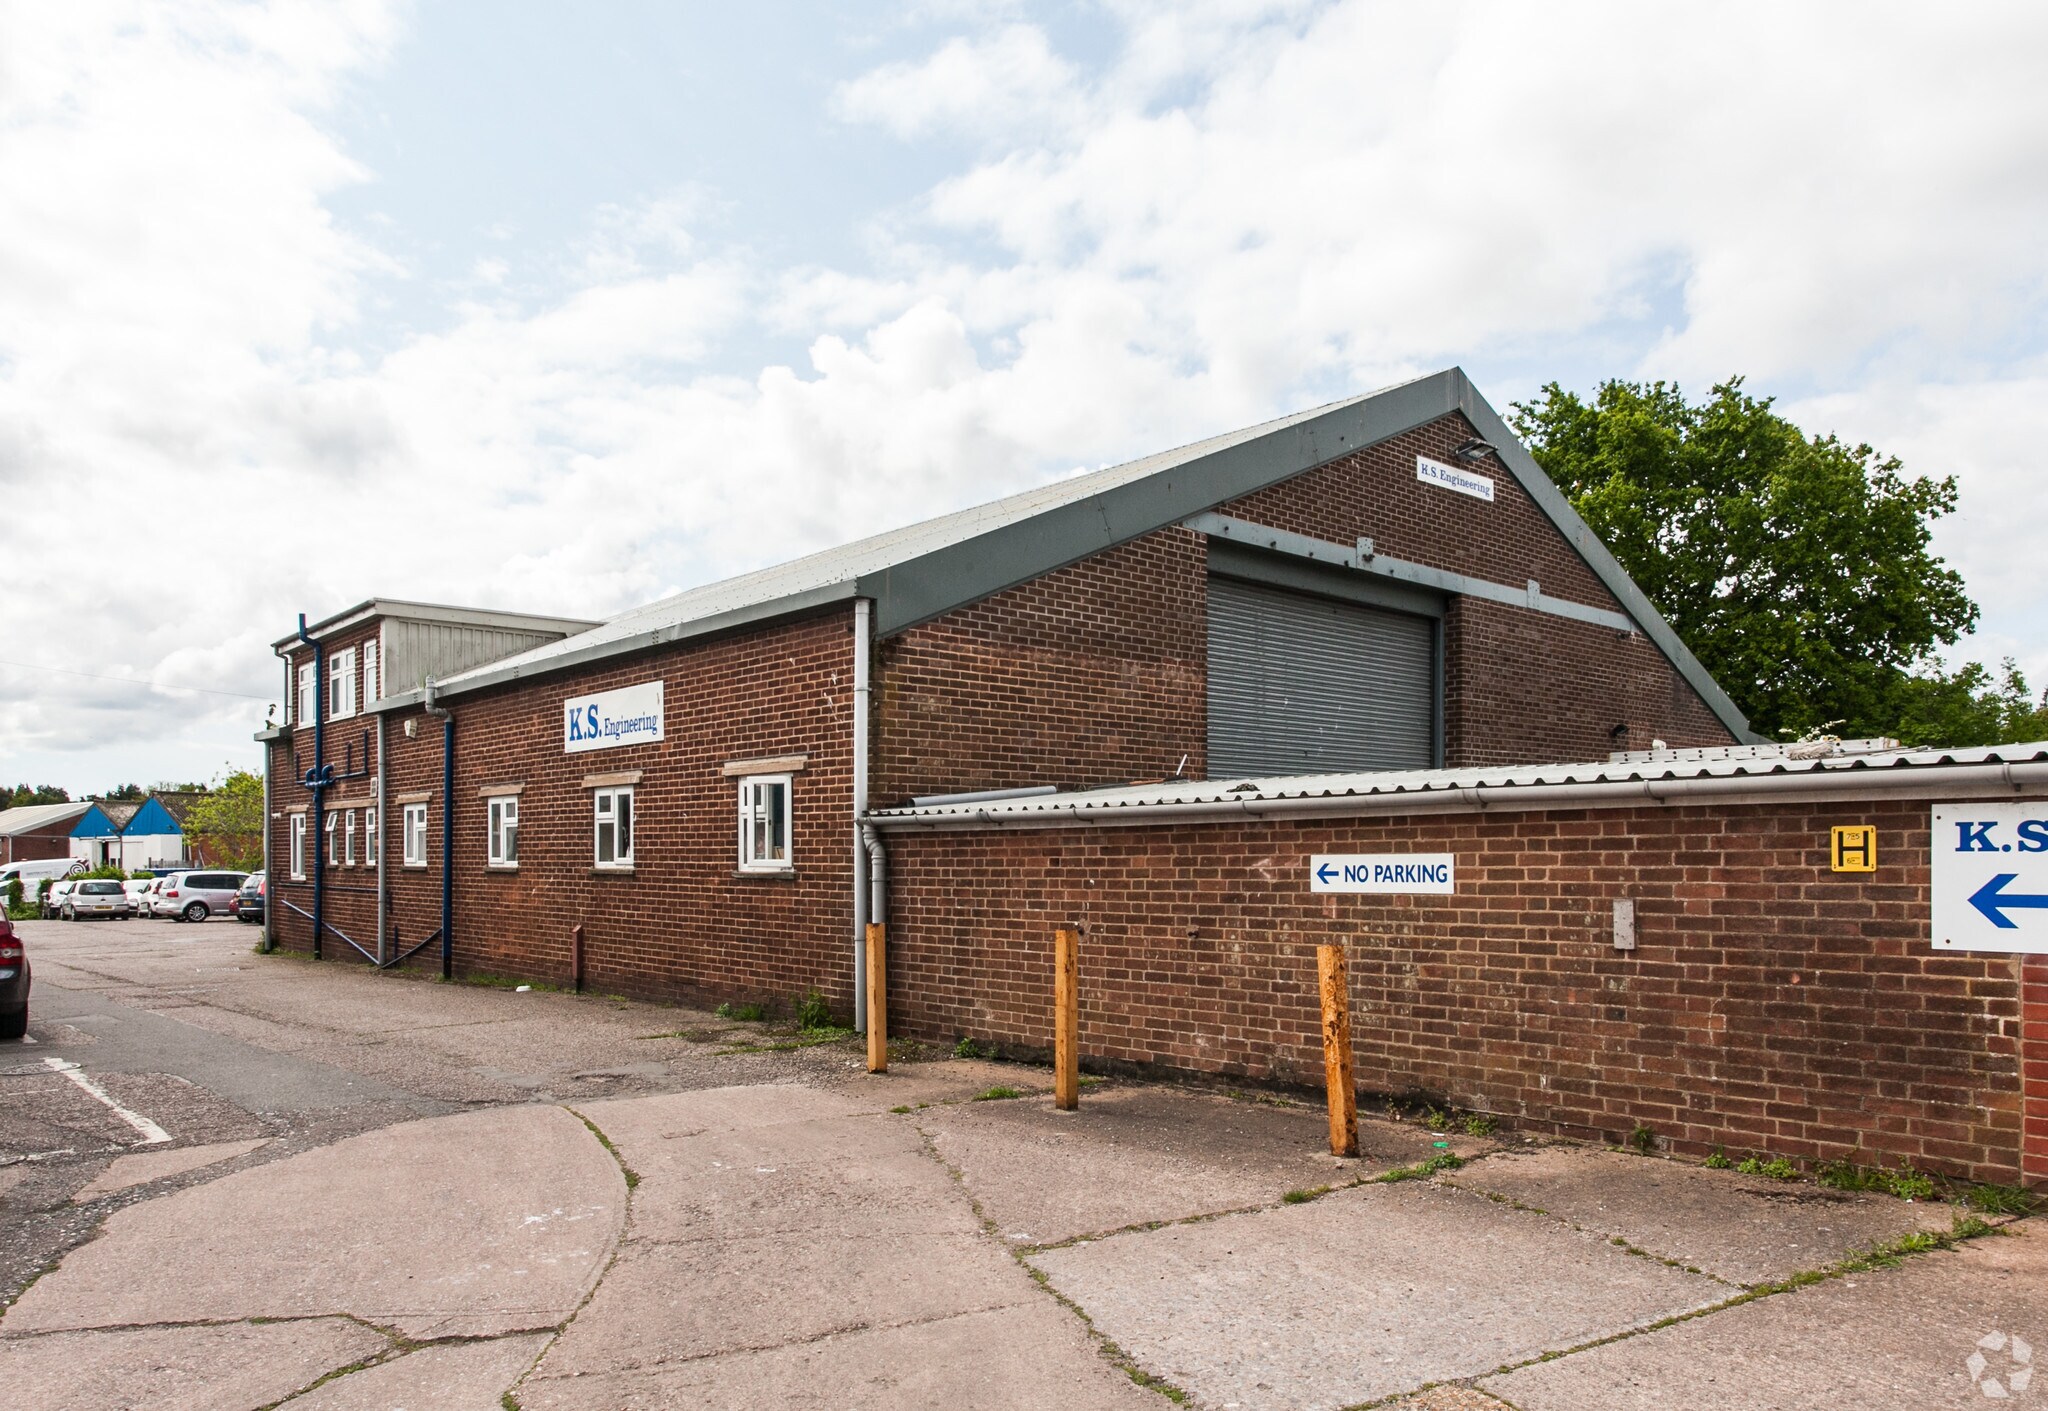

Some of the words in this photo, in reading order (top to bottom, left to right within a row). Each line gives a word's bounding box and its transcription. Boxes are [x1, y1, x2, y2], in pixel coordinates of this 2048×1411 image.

[1440, 469, 1490, 497] Engineering
[569, 704, 602, 741] K.S.
[604, 711, 657, 741] Engineering
[1344, 864, 1369, 883] NO
[1374, 864, 1448, 883] PARKING
